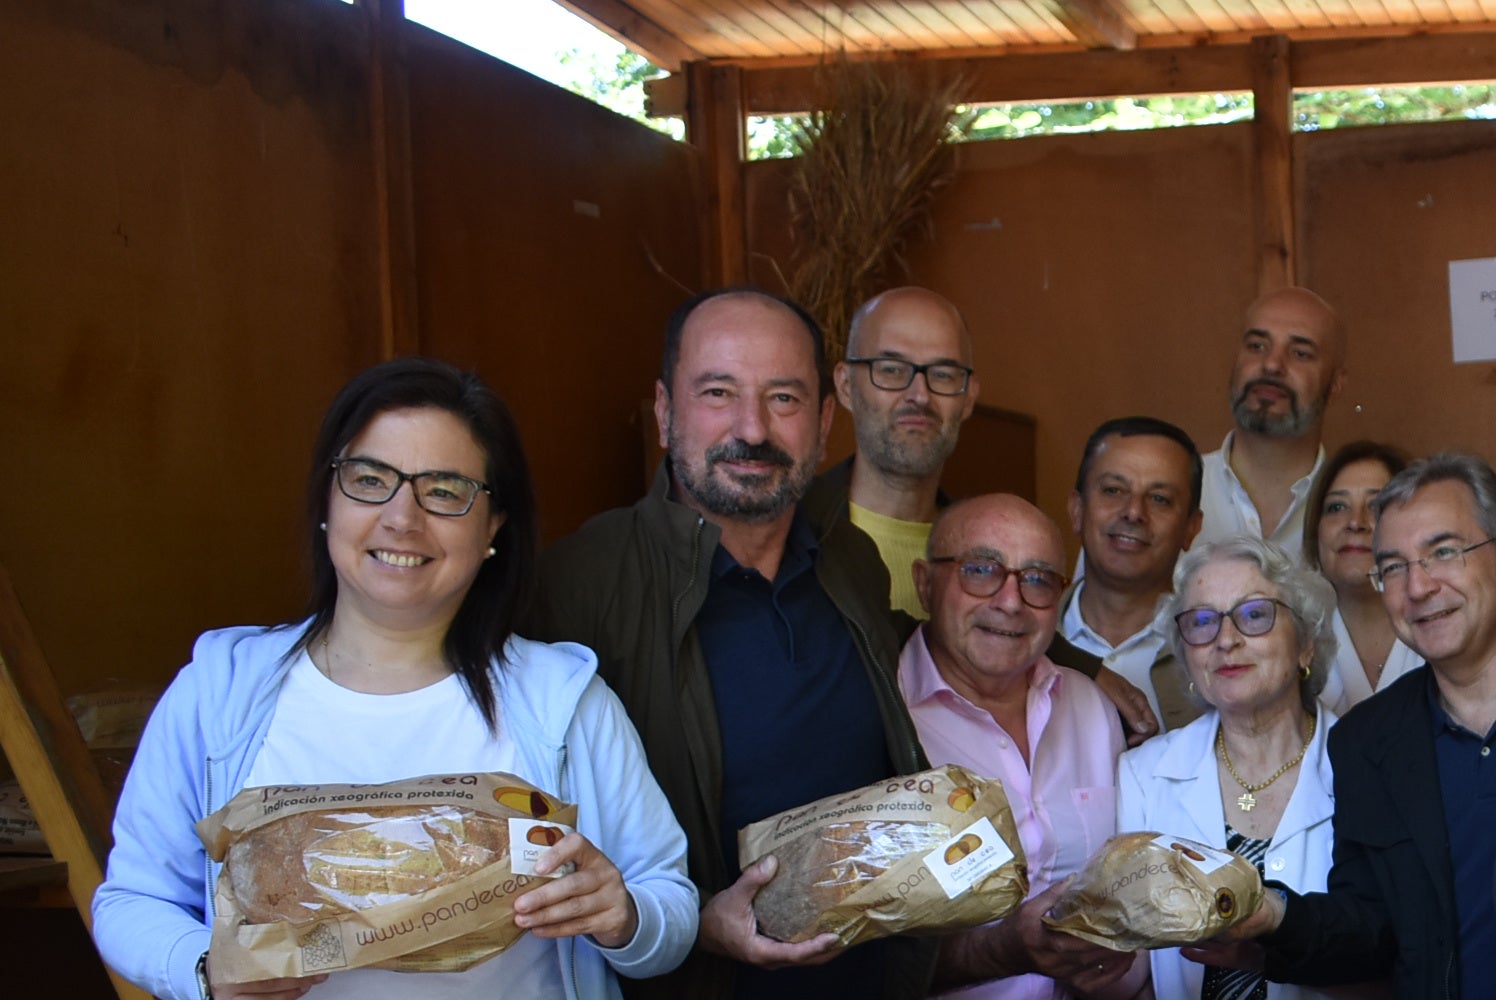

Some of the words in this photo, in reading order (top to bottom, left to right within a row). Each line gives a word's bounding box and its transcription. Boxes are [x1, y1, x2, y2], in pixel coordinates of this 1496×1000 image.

[418, 775, 478, 787] ea
[886, 778, 935, 795] cea
[263, 794, 326, 816] indicación
[330, 788, 402, 803] xeográfica
[407, 789, 474, 800] protexida
[876, 801, 933, 813] protexida
